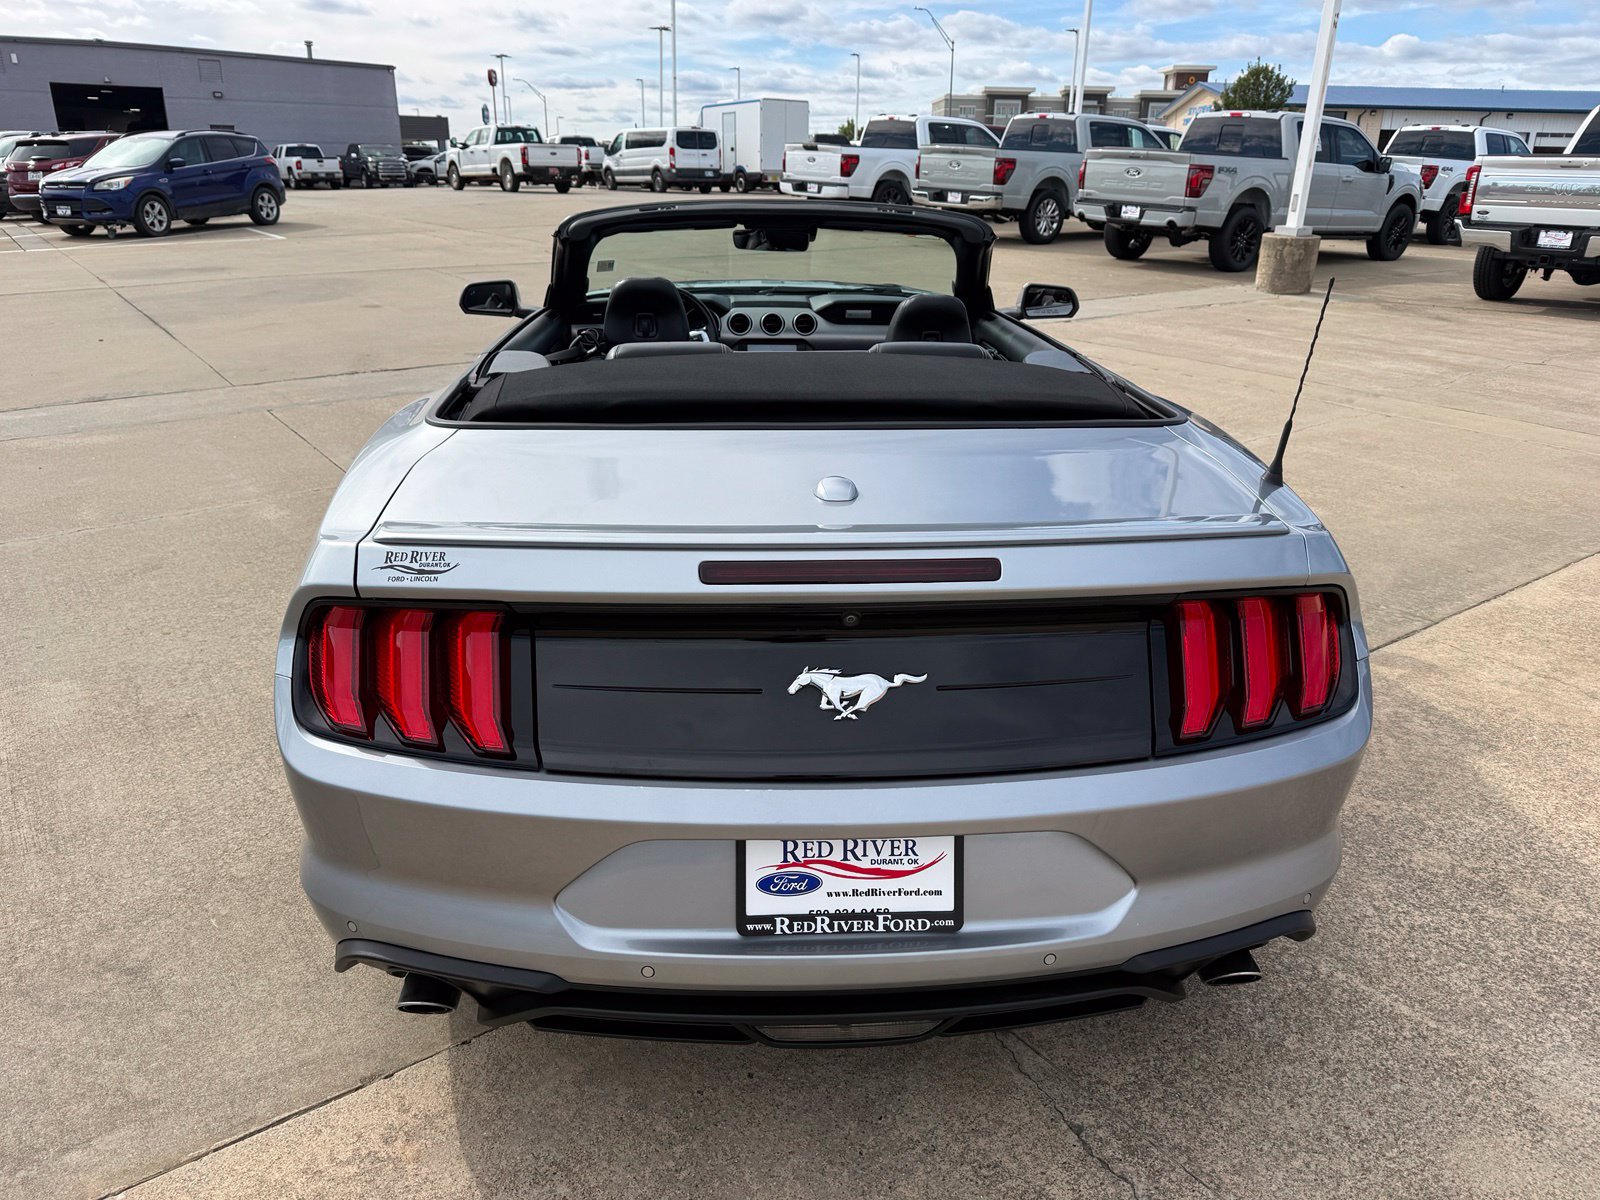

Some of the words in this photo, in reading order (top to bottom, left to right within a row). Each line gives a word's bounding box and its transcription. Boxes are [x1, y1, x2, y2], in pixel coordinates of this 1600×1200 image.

[384, 550, 408, 564] RED
[409, 550, 446, 564] RIVER
[780, 839, 834, 863] RED
[840, 838, 919, 862] RIVER
[870, 858, 905, 866] DURANT,
[907, 858, 919, 866] OK
[769, 875, 808, 892] Ford
[826, 887, 943, 898] www.RedRiverFord.com
